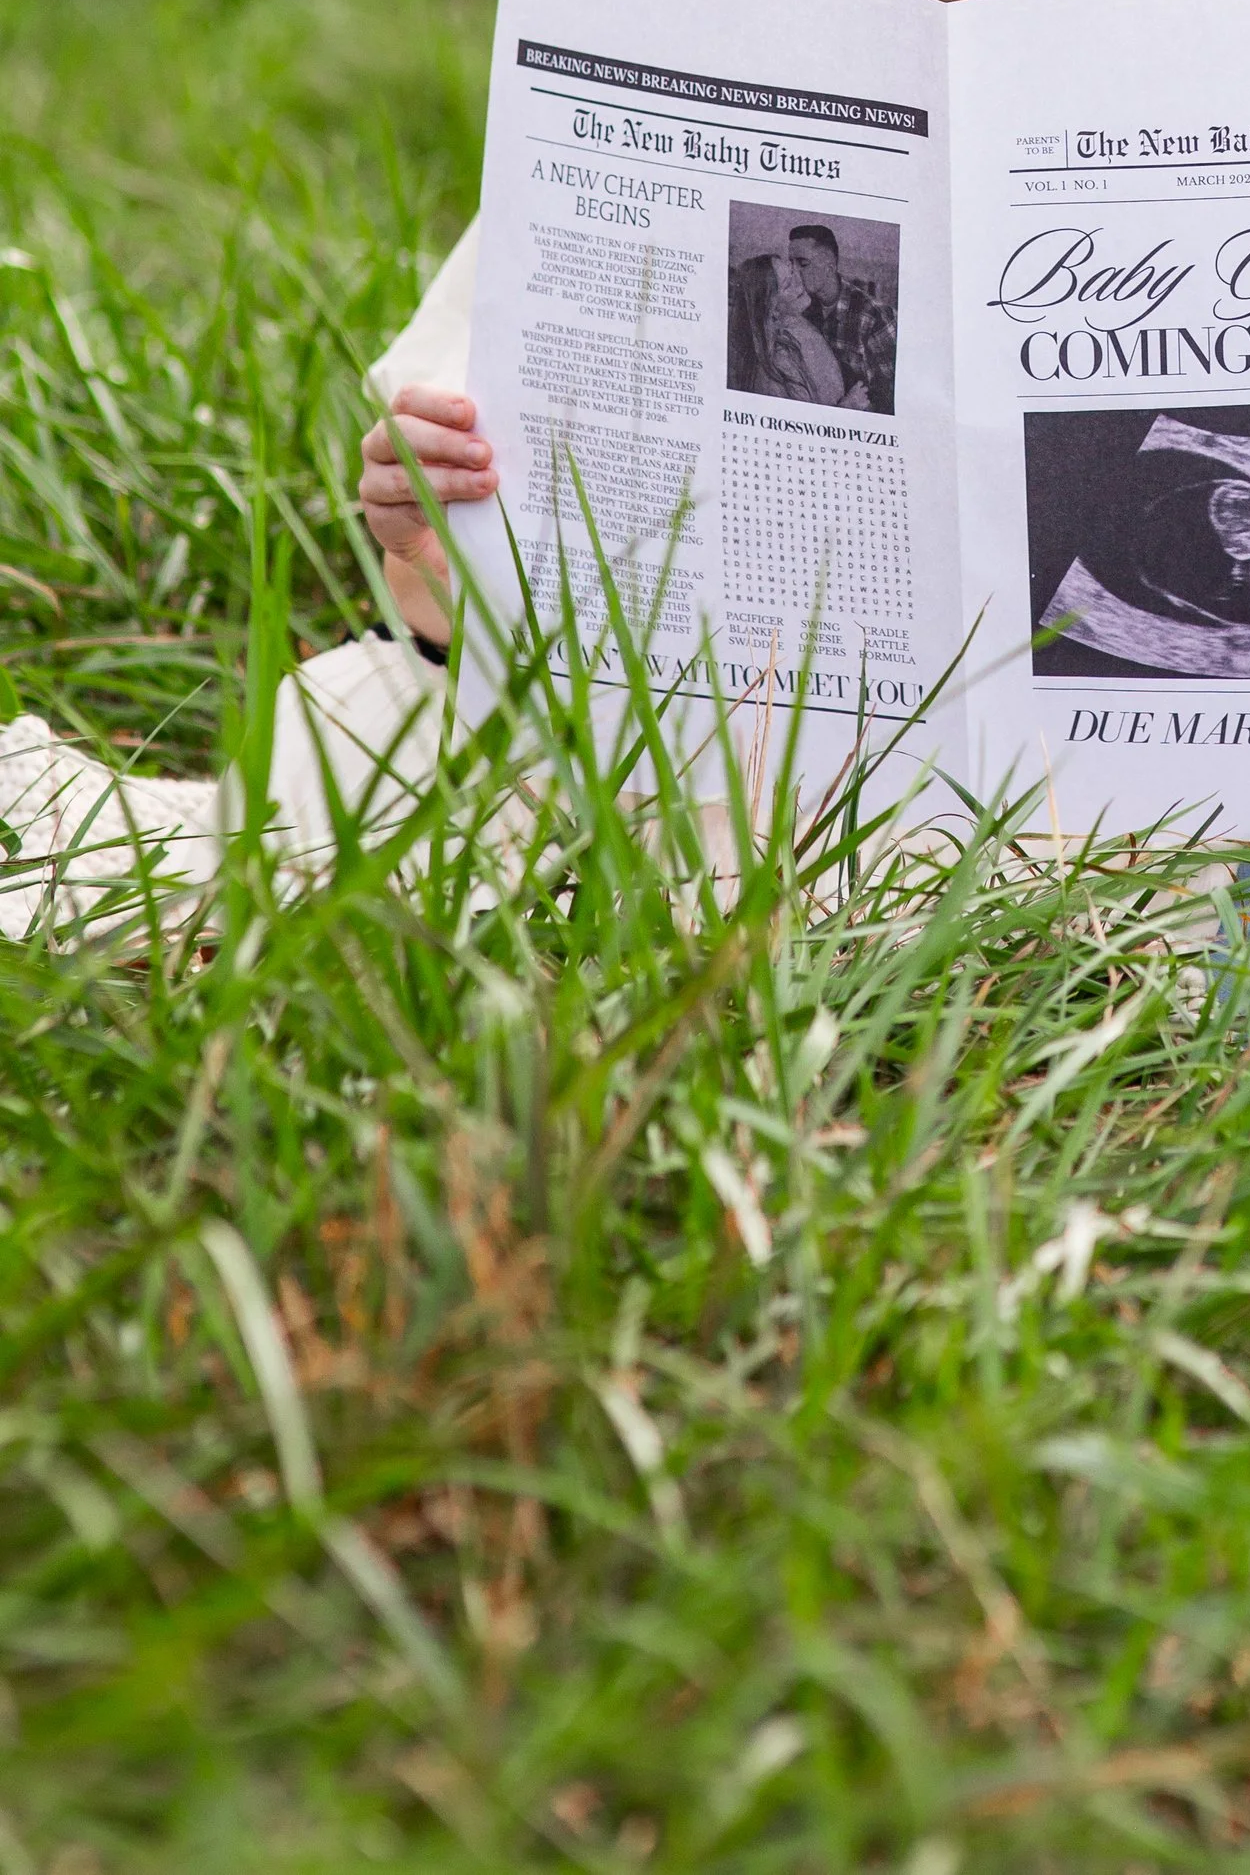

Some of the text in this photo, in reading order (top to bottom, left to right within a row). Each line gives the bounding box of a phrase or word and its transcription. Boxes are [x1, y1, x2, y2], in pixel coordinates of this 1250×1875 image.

[525, 48, 916, 129] BREAKING NEWS! BREAKING NEWS! BREAKING NEWS!
[573, 108, 840, 180] The New Baby Times
[1016, 136, 1060, 145] PARENTS
[1025, 145, 1054, 155] TO BE
[1077, 130, 1129, 164] The
[1139, 128, 1199, 156] New
[531, 159, 705, 210] A NEW CHAPTER
[1025, 180, 1058, 192] VOL.
[1074, 179, 1099, 191] NO.
[1176, 175, 1225, 187] MARCH
[575, 195, 650, 227] BEGINS
[534, 236, 551, 247] HAS
[553, 240, 585, 254] FAMILY
[587, 247, 606, 258] AND
[609, 251, 648, 266] FRIENDS
[547, 226, 593, 243] STUNNING
[597, 237, 621, 249] TURN
[638, 244, 676, 259] EVENTS
[679, 251, 705, 264] THAT
[532, 272, 576, 289] ADDITION
[595, 284, 622, 297] THEIR
[541, 250, 688, 285] THE GOSWICK HOUSEHOLD HAS
[541, 262, 596, 281] CONFIRMED
[614, 276, 660, 292] EXCITING
[662, 285, 685, 296] NEW
[986, 227, 1196, 331] Baby
[526, 283, 553, 296] RIGHT
[562, 290, 585, 302] BABY
[586, 295, 633, 311] GOSWICK
[645, 305, 702, 323] OFFICIALLY
[535, 321, 689, 357] AFTER MUCH SPECULATION AND
[524, 343, 553, 356] CLOSE
[572, 352, 592, 363] THE
[593, 356, 628, 369] FAMILY
[678, 370, 699, 382] THE
[526, 355, 696, 394] EXPECTANT PARENTS THEMSELVES)
[657, 355, 703, 370] SOURCES
[518, 365, 705, 406] HAVE JOYFULLY REVEALED THAT THEIR
[521, 378, 571, 395] GREATEST
[572, 387, 630, 405] ADVENTURE
[631, 397, 651, 409] YET
[664, 403, 682, 414] SET
[547, 394, 578, 407] BEGIN
[592, 402, 628, 416] MARCH
[723, 409, 900, 447] BABY CROSSWORD PUZZLE
[725, 611, 784, 626] PACIFICER
[863, 625, 909, 639] CRADLE
[728, 636, 784, 651] SWADDE
[799, 631, 843, 644] ONESIE
[723, 662, 764, 689] TO
[771, 668, 850, 699] MEET
[1064, 709, 1154, 744] DUE
